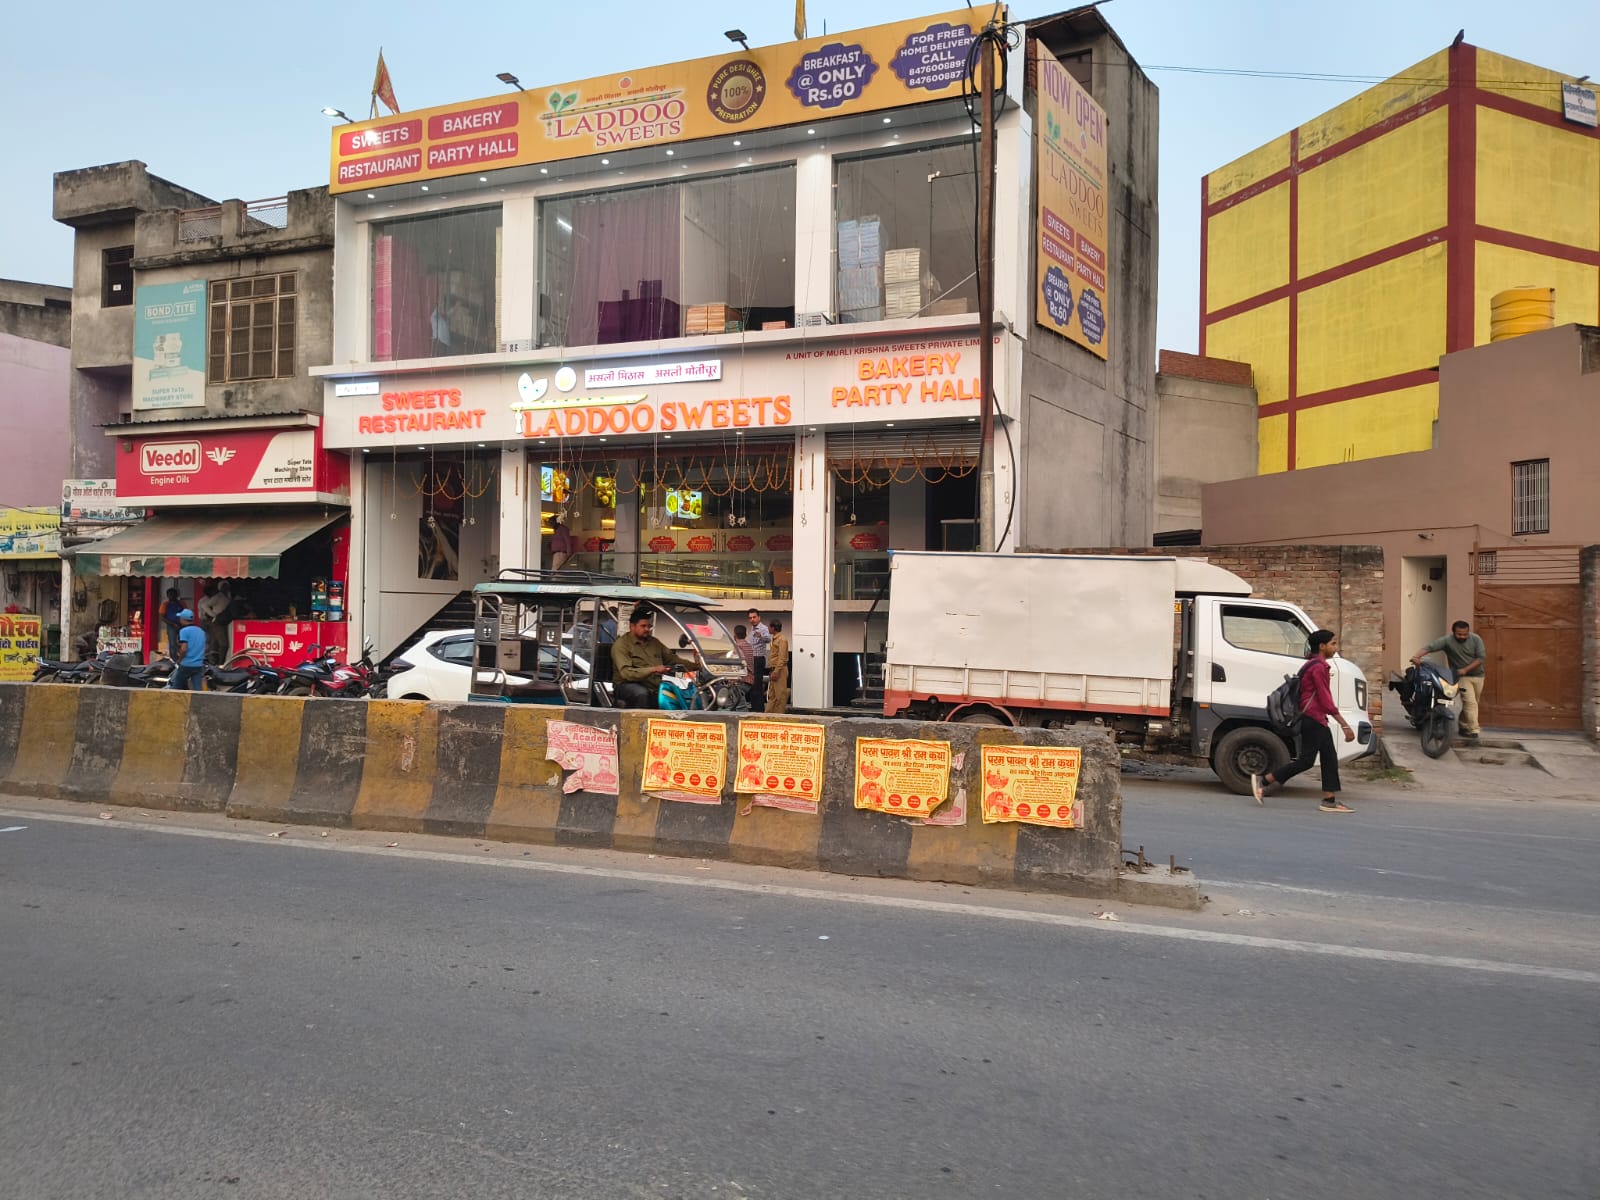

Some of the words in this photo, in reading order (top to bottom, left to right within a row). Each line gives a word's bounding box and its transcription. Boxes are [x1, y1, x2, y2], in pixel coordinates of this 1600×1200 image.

[901, 46, 928, 57] HOME
[930, 36, 976, 52] DELIVERY
[912, 34, 934, 45] FOR
[937, 28, 964, 40] FREE
[804, 51, 860, 71] BREAKFAST
[921, 51, 954, 64] CALL
[713, 69, 728, 89] PURE
[729, 63, 746, 73] DESI
[798, 74, 814, 90] @
[818, 64, 866, 84] ONLY
[724, 85, 749, 99] 100%
[808, 82, 855, 103] Rs.60
[1043, 54, 1071, 115] NOW
[1075, 90, 1103, 149] OPEN
[443, 110, 502, 133] BAKERY
[555, 100, 685, 138] LADDOO
[715, 101, 759, 121] PREPARATION
[352, 127, 409, 149] SWEETS
[596, 120, 681, 146] SWEETS
[430, 145, 474, 165] PARTY
[478, 138, 516, 157] HALL
[340, 154, 420, 179] RESTAURANT
[1051, 151, 1104, 218] LADDOO
[1047, 214, 1071, 241] SWEETS
[1053, 289, 1070, 309] ONLY
[147, 306, 171, 318] BOND
[175, 303, 196, 314] TITE
[793, 351, 811, 360] UNIT
[813, 350, 824, 358] OF
[826, 348, 852, 357] MURLI
[854, 346, 890, 356] KRISHNA
[891, 342, 926, 354] SWEETS
[927, 339, 963, 350] PRIVATE
[965, 336, 1000, 347] LIMD
[588, 370, 615, 382] असली
[618, 369, 645, 381] मिठास
[654, 365, 682, 378] असली
[685, 363, 717, 378] मोतीचूर
[858, 352, 961, 381] BAKERY
[381, 388, 461, 411] SWEETS
[832, 382, 912, 408] PARTY
[920, 377, 982, 403] HALL
[359, 409, 486, 434] RESTAURANT
[523, 403, 655, 438] LADDOO
[660, 394, 793, 431] SWEETS
[146, 448, 197, 468] Veedol
[150, 475, 174, 486] Engine
[176, 474, 190, 484] Oils
[248, 640, 280, 651] Veedol
[780, 730, 789, 742] श्री
[791, 733, 802, 743] राम
[902, 746, 912, 758] श्री
[914, 750, 927, 760] राम
[1030, 755, 1039, 768] श्री
[1042, 758, 1055, 768] राम
